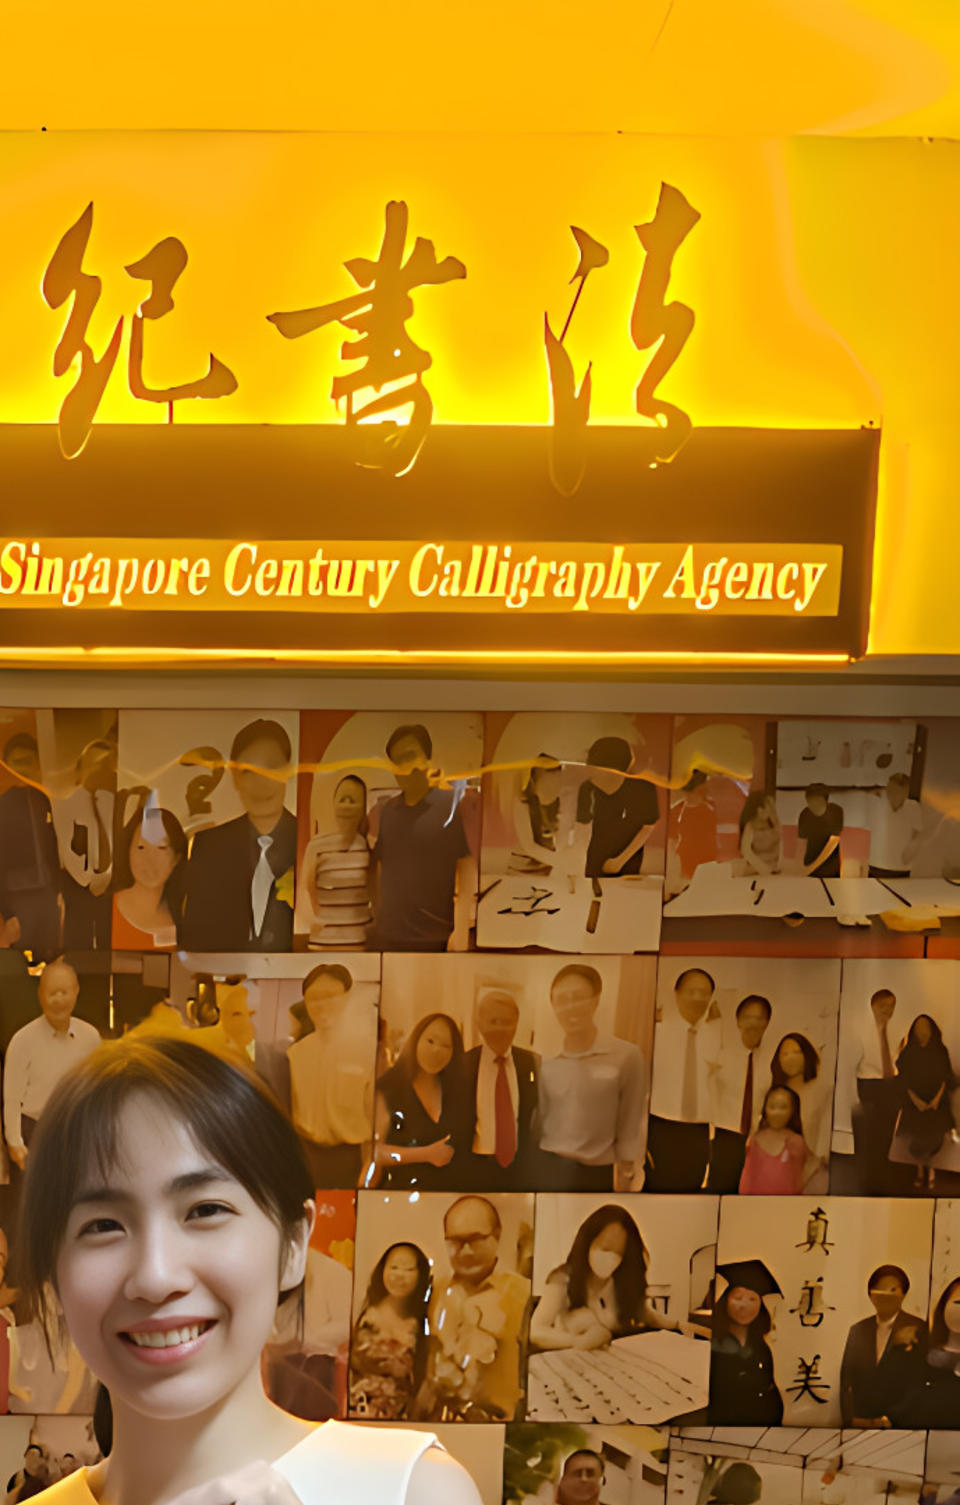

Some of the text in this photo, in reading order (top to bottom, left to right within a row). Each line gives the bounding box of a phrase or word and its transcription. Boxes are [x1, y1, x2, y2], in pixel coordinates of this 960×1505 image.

[224, 542, 400, 608] Century
[408, 543, 662, 611] Calligraphy
[663, 544, 828, 611] Agency
